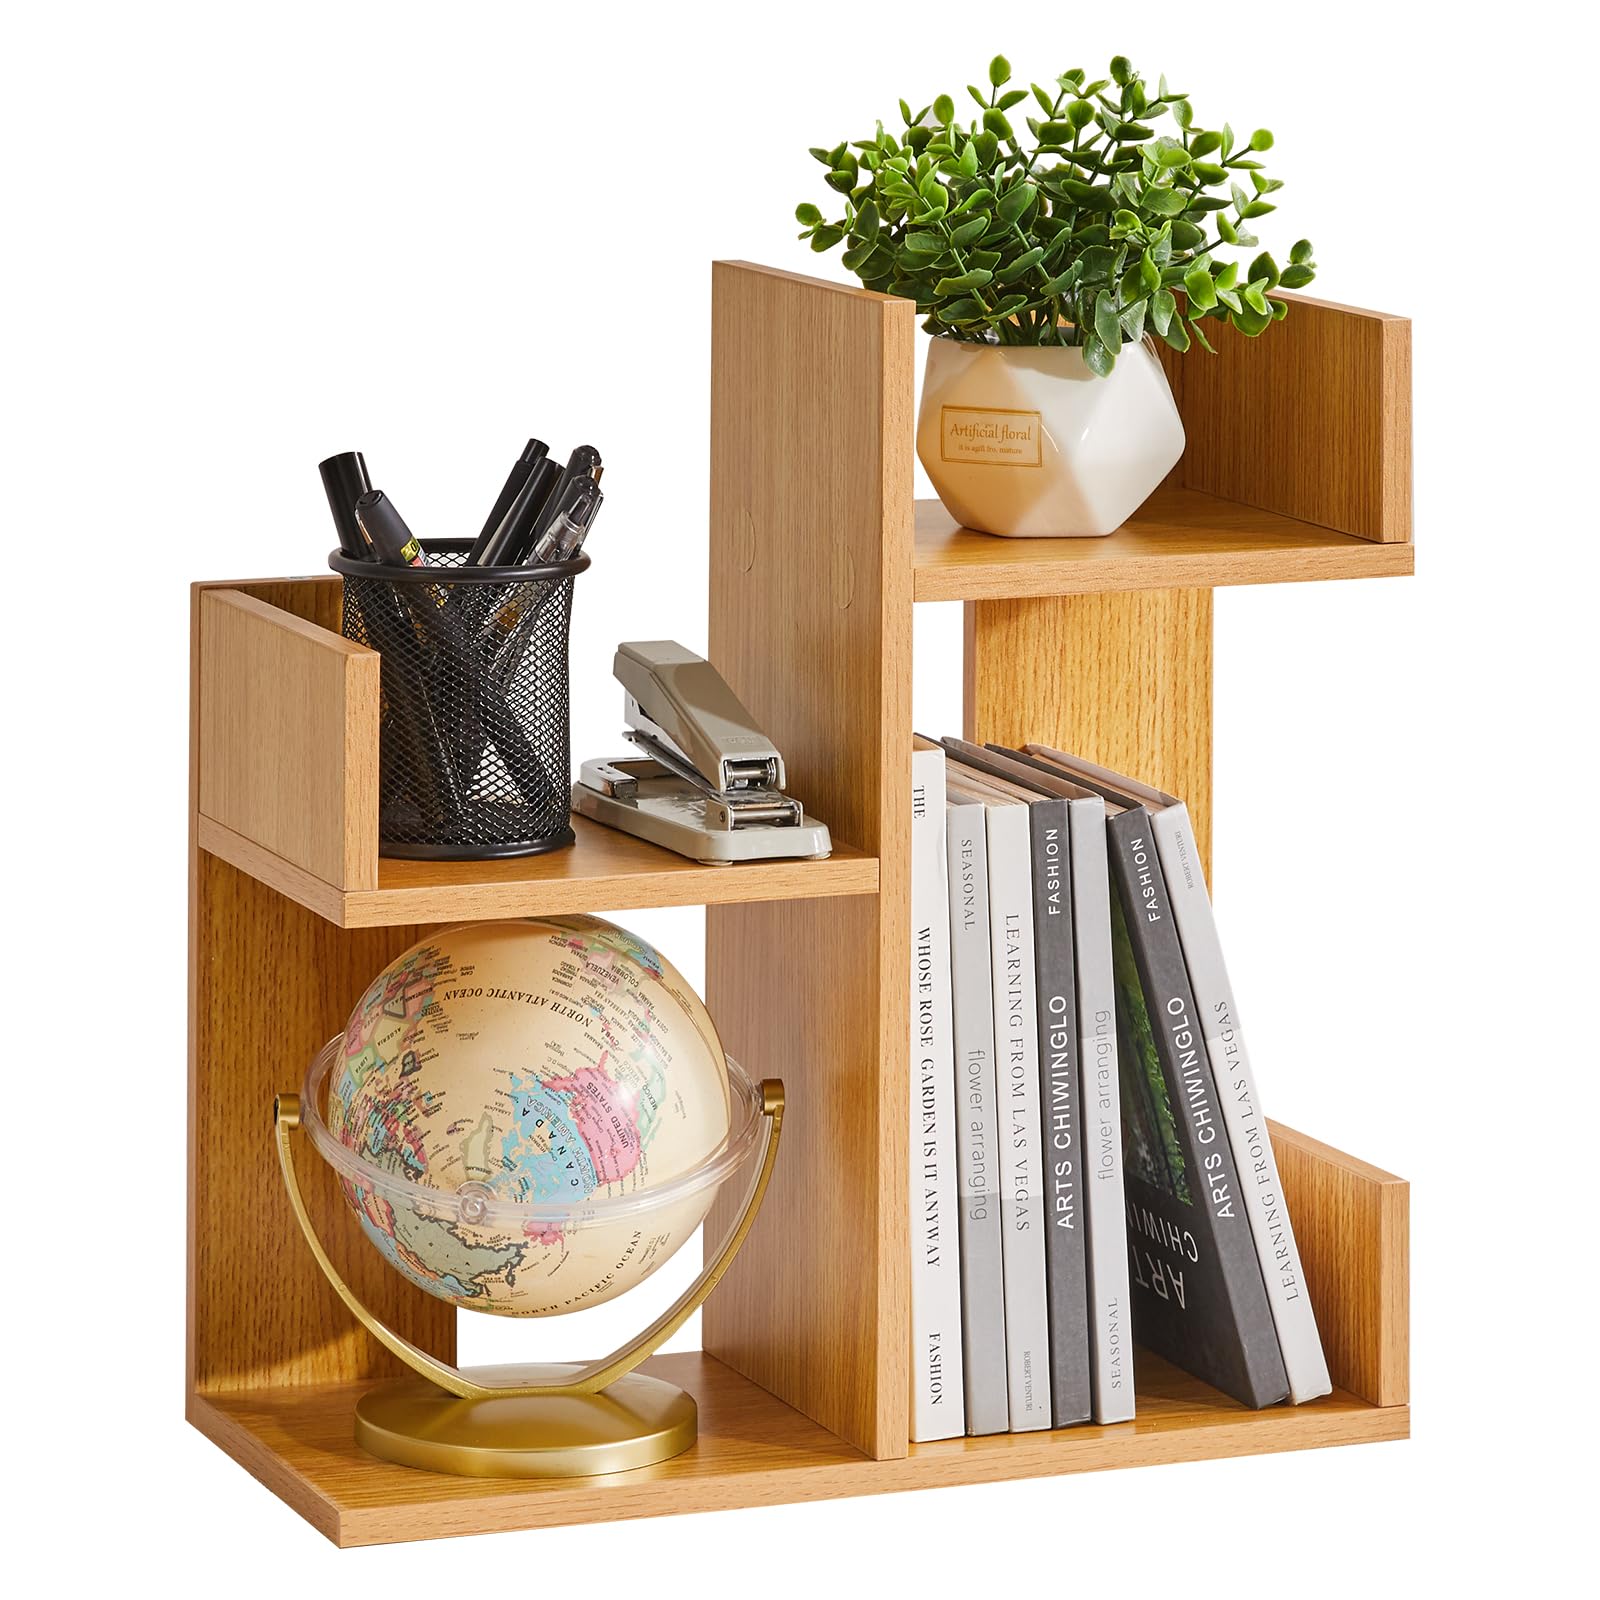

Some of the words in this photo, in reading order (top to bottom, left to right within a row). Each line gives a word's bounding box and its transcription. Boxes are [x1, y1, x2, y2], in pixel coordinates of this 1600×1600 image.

[950, 422, 998, 442] Artificial
[998, 423, 1031, 444] floral
[913, 785, 926, 819] THE
[961, 839, 976, 931] SEASONAL
[1045, 829, 1061, 915] FASHION
[1130, 838, 1161, 922] FASHION
[585, 961, 620, 985] VENEZUELA
[610, 965, 640, 987] COLOMBIA
[917, 927, 932, 993] WHOSE
[1005, 914, 1023, 1027] LEARNING
[443, 988, 483, 1001] OCEAN
[486, 989, 549, 1007] ATLANTIC
[550, 1002, 593, 1028] NORTH
[919, 1000, 934, 1047] ROSE
[354, 1057, 370, 1073] LIBYA
[377, 1028, 402, 1046] ALGERIA
[600, 1027, 620, 1046] CUBA
[1092, 1010, 1112, 1109] arranging
[1214, 1001, 1241, 1072] VEGAS
[587, 1081, 612, 1114] STATES
[641, 1084, 659, 1110] MEXICO
[920, 1058, 937, 1135] GARDEN
[967, 1049, 986, 1112] flower
[1010, 1038, 1026, 1097] FROM
[1048, 996, 1072, 1149] CHIWINGLO
[1167, 997, 1216, 1144] CHIWINGLO
[526, 1095, 577, 1147] AMERICA
[1012, 1109, 1028, 1149] LAS
[1233, 1079, 1254, 1119] LAS
[611, 1115, 629, 1148] UNITED
[923, 1140, 937, 1157] IS
[1097, 1118, 1115, 1180] flower
[1245, 1126, 1270, 1185] FROM
[571, 1146, 595, 1195] NORTH
[924, 1164, 938, 1181] IT
[968, 1121, 990, 1221] arranging
[1014, 1159, 1030, 1232] VEGAS
[1055, 1160, 1074, 1229] ARTS
[1204, 1153, 1235, 1218] ARTS
[924, 1188, 941, 1267] ANYWAY
[1262, 1192, 1299, 1301] LEARNING
[512, 1304, 559, 1315] NORTH
[564, 1272, 615, 1305] PACIFIC
[615, 1230, 642, 1270] OCEAN
[1133, 1245, 1186, 1310] ART
[929, 1332, 943, 1405] FASHION
[1107, 1298, 1121, 1389] SEASONAL
